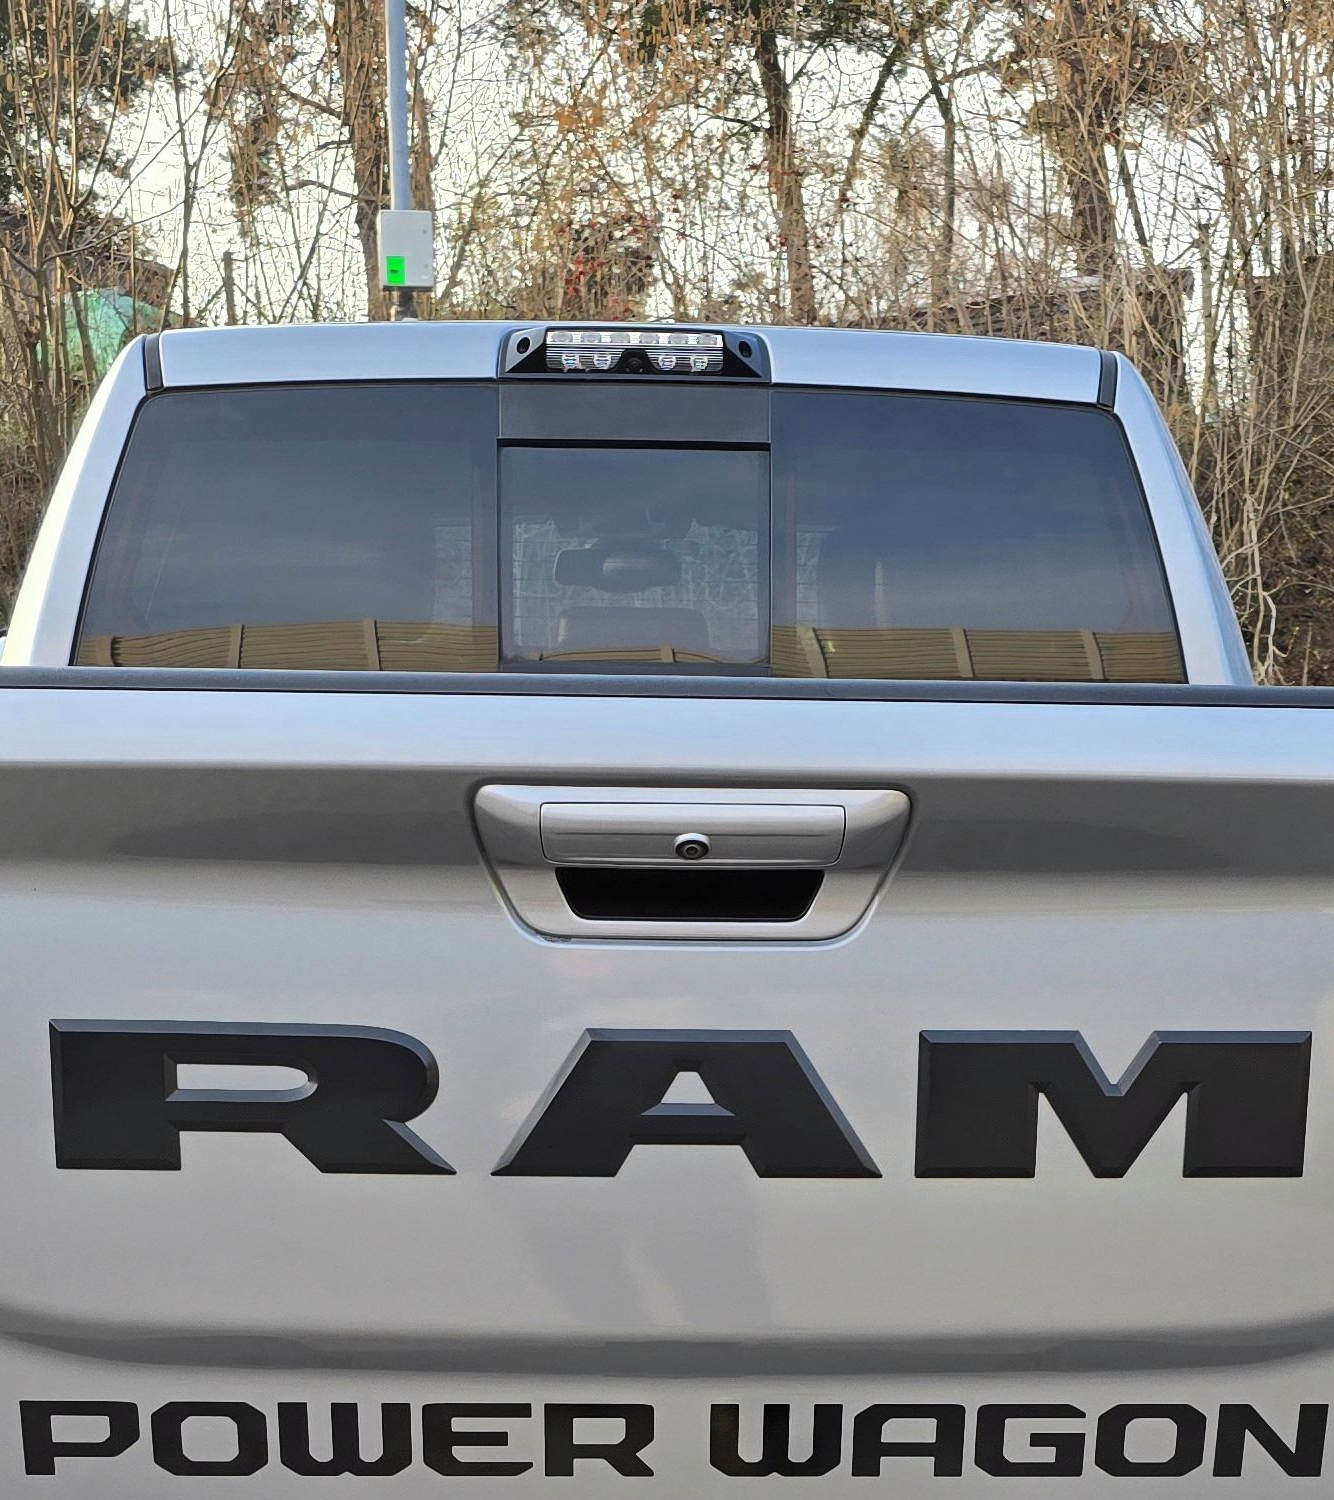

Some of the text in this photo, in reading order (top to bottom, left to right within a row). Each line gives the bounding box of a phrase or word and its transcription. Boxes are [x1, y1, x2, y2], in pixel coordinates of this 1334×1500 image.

[49, 1019, 1312, 1178] RAM
[19, 1400, 1329, 1477] POWER WAGON
